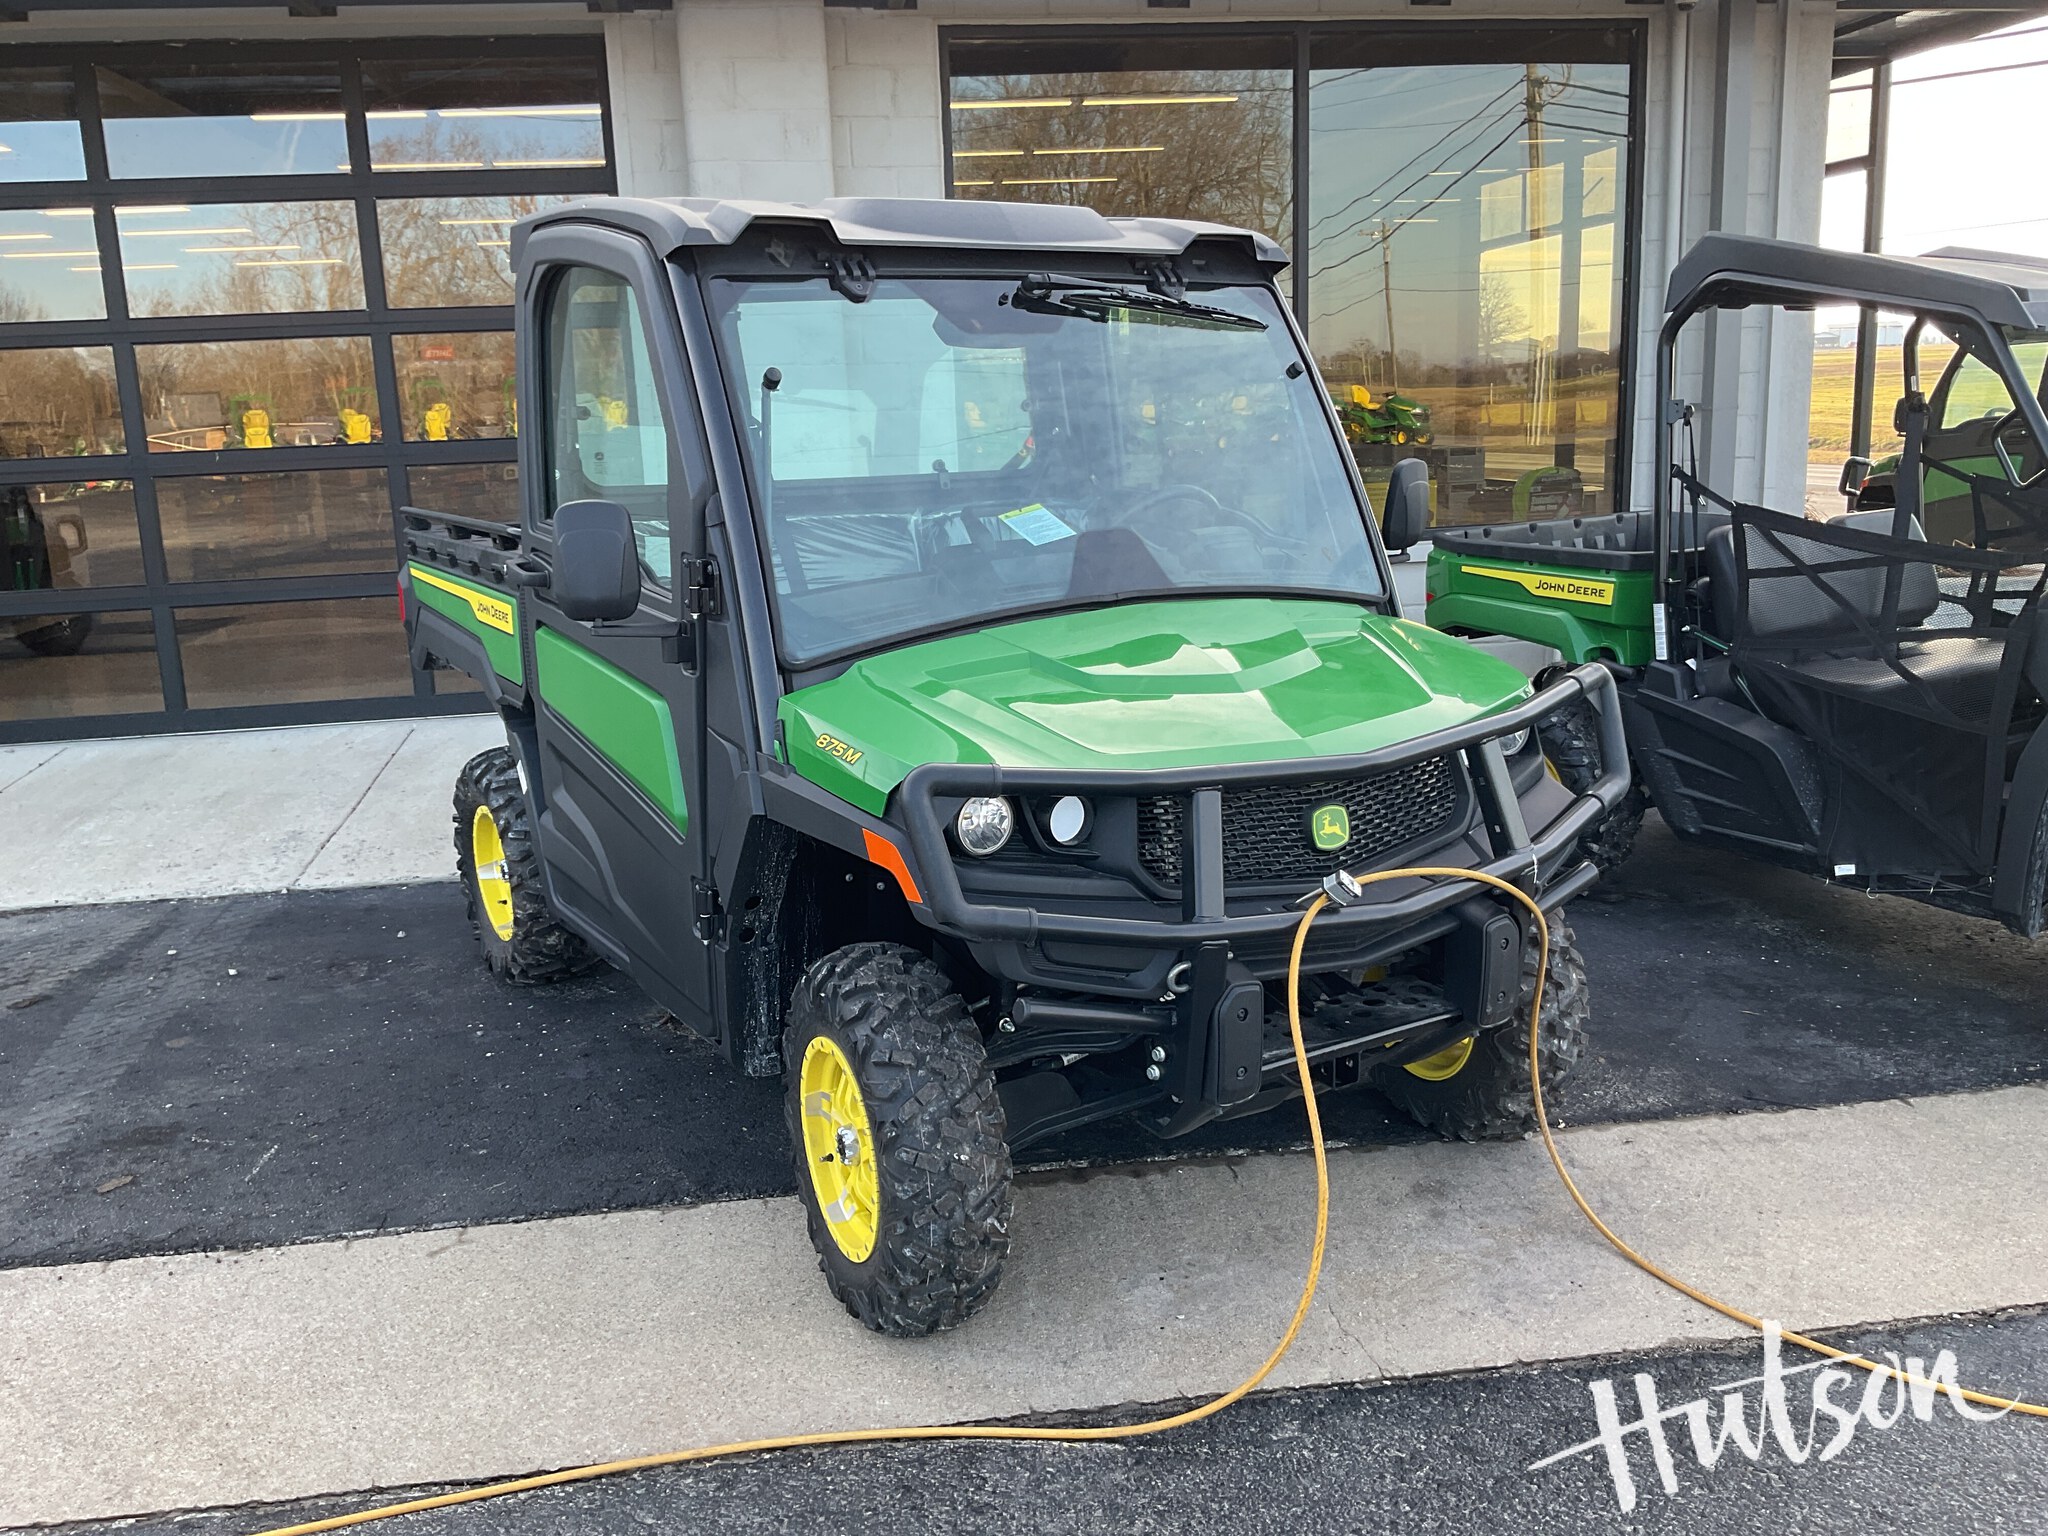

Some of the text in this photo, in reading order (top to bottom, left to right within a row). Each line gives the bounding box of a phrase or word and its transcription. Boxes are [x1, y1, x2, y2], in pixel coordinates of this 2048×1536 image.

[1535, 579, 1606, 598] JOHN DEERE
[477, 600, 509, 624] JOHN DEERE
[815, 733, 864, 766] 875M
